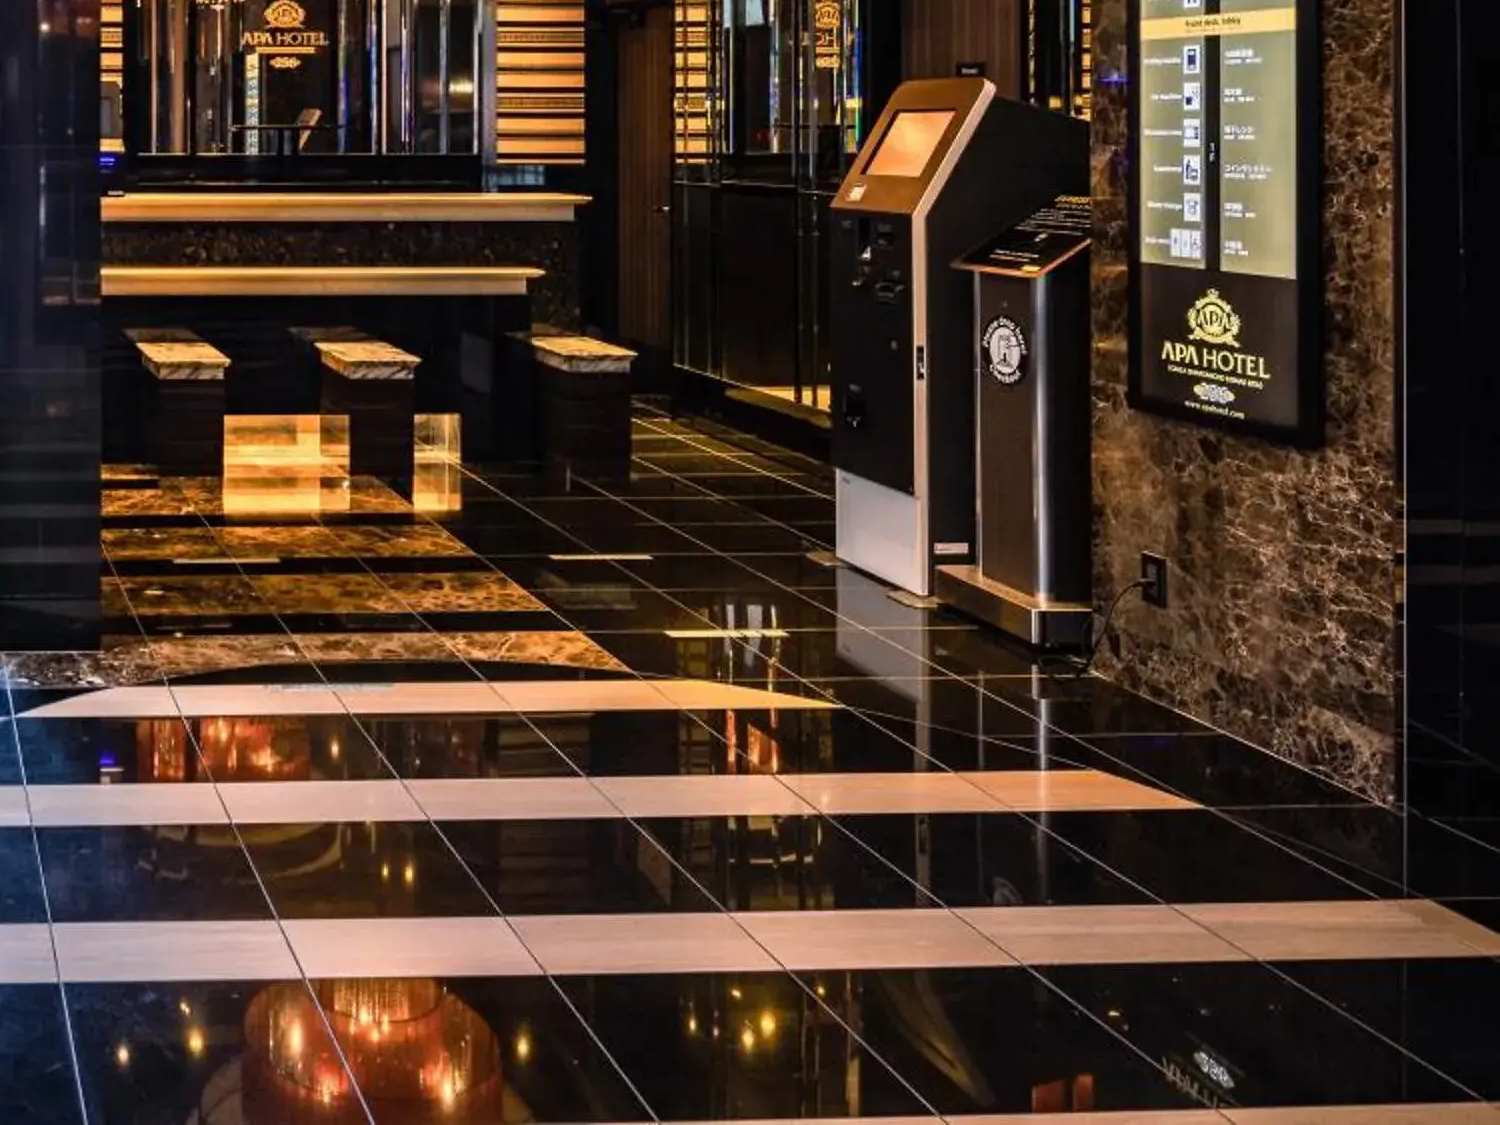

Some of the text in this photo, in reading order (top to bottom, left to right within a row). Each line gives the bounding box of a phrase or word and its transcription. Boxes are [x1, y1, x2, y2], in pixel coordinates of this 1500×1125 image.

[242, 31, 330, 46] APA HOTEL
[1161, 340, 1199, 366] APA
[1202, 347, 1272, 380] HOTEL
